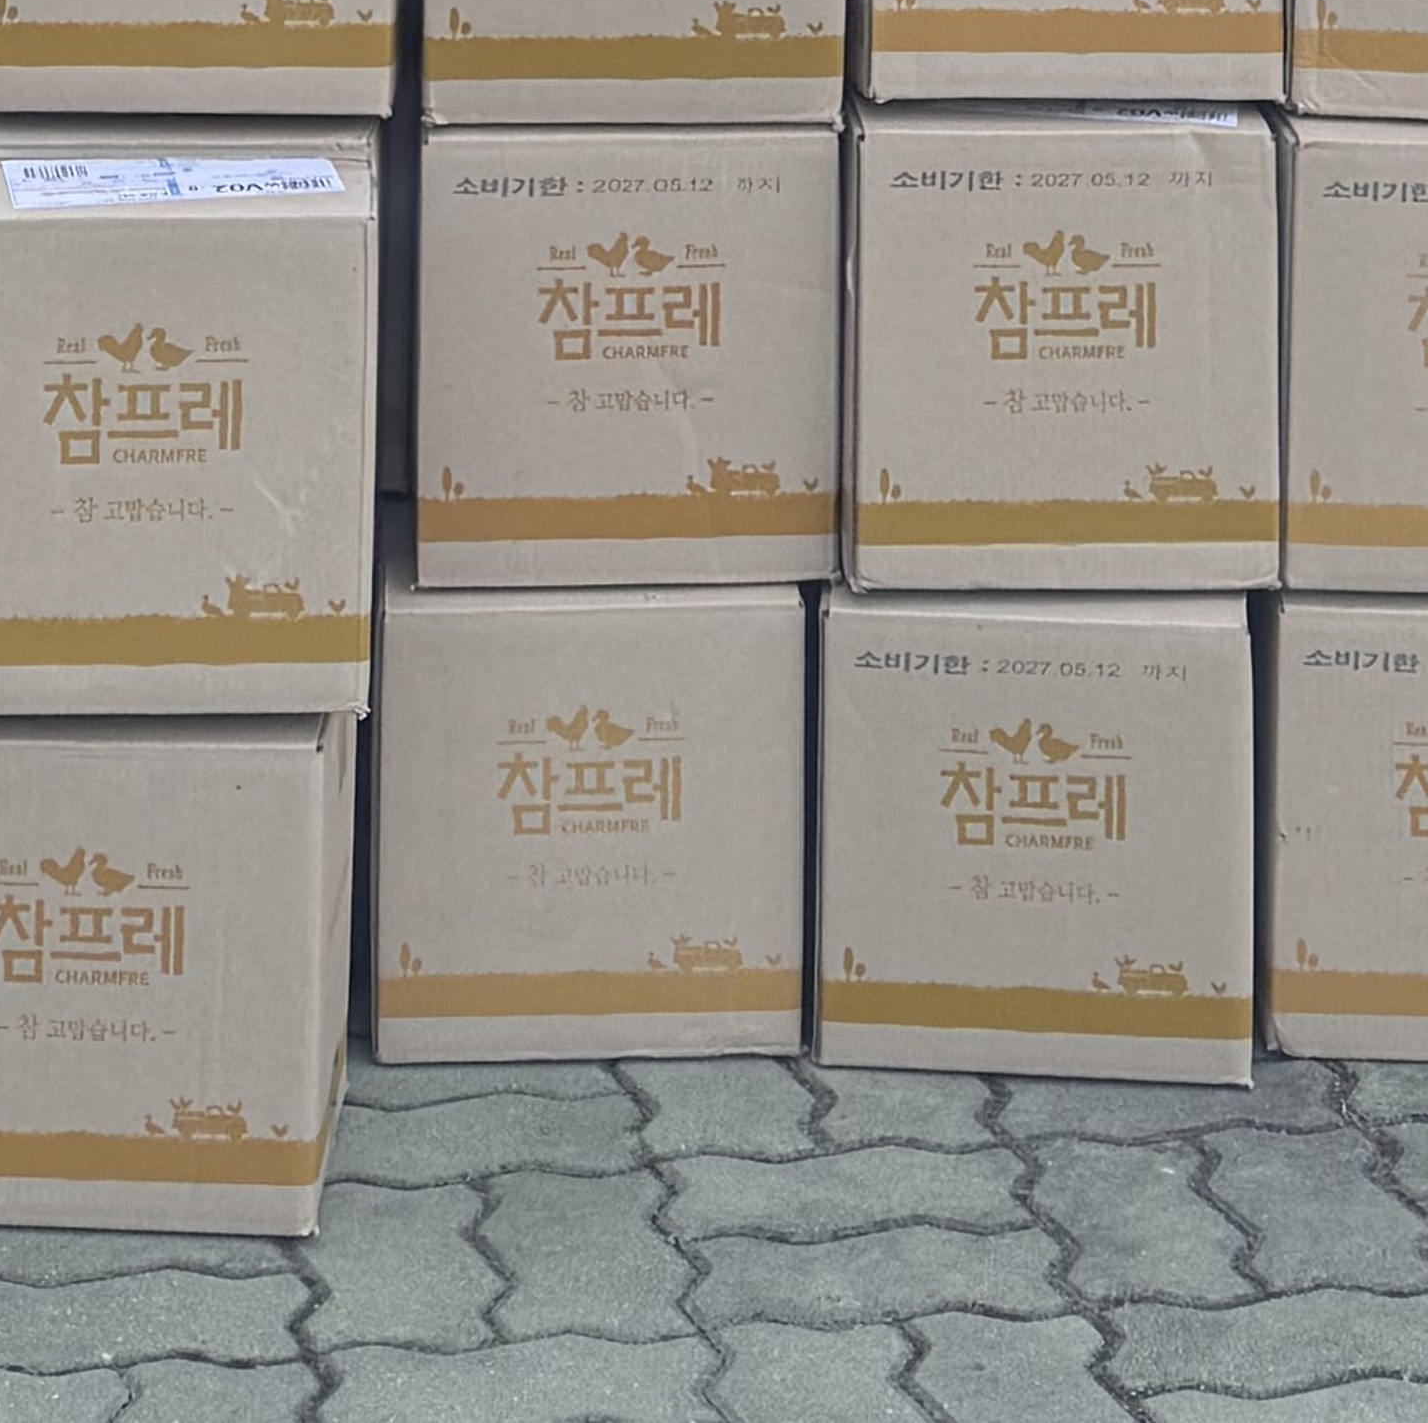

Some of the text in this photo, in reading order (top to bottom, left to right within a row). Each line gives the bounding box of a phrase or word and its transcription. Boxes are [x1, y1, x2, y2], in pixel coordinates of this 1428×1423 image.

[737, 176, 781, 194] 까지
[1168, 172, 1213, 188] 까지
[549, 244, 718, 261] Real Fresh
[986, 243, 1154, 259] Real Fresh
[538, 279, 721, 360] 참프레
[974, 276, 1156, 360] 참프레
[56, 336, 241, 354] Real Fresh
[602, 345, 689, 359] CHARMFRE
[1039, 346, 1125, 359] CHARMFRE
[569, 389, 590, 413] 참
[1005, 389, 1026, 414] 참
[43, 374, 242, 465] 참프레
[113, 449, 207, 463] CHARMFRE
[75, 498, 97, 523] 참
[1143, 664, 1187, 681] 까지
[951, 728, 1123, 749] Real Fresh
[497, 753, 681, 834] 참프레
[940, 761, 1126, 845] 참프레
[1005, 834, 1094, 850] CHARMFRE
[0, 859, 183, 880] Real Fresh
[972, 875, 991, 900] 참
[55, 970, 150, 985] CHARMFRE
[18, 1014, 39, 1040] 참
